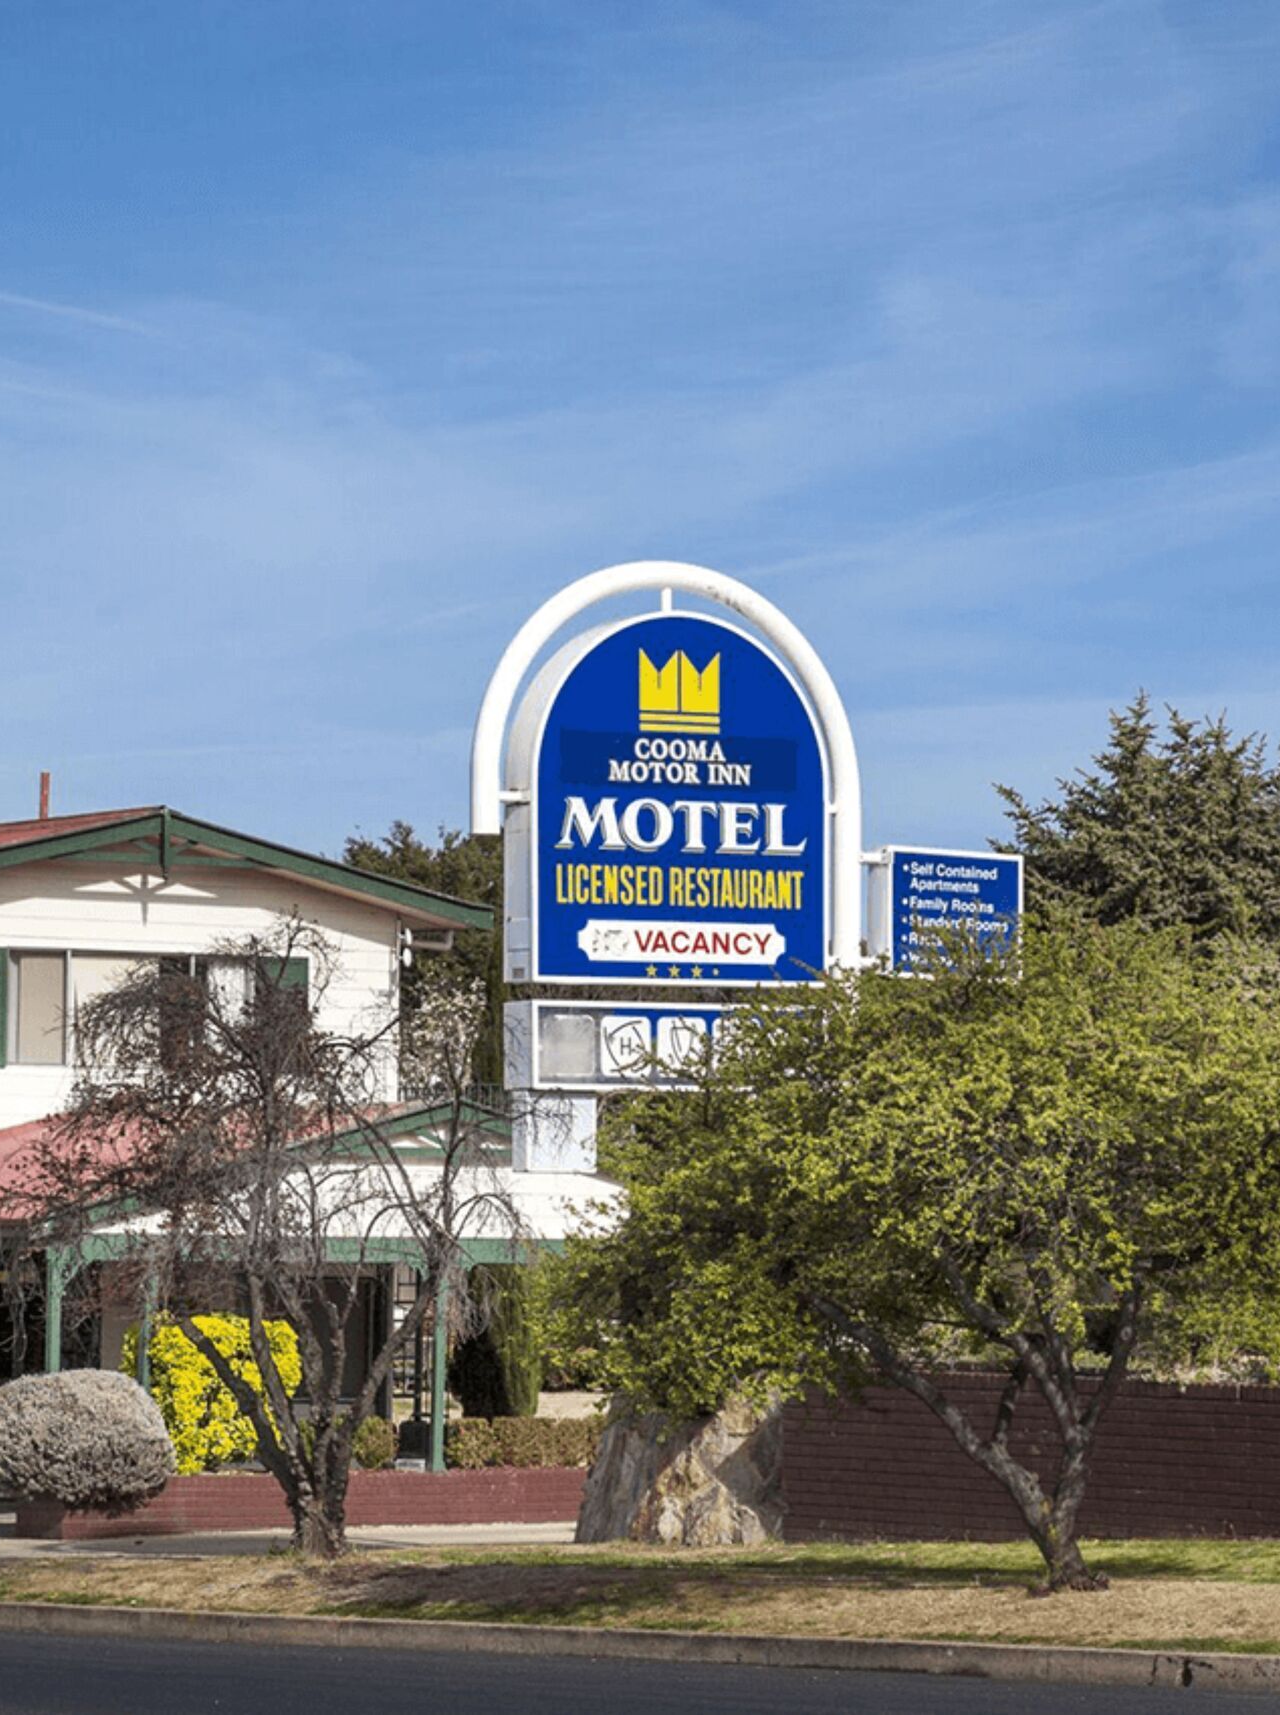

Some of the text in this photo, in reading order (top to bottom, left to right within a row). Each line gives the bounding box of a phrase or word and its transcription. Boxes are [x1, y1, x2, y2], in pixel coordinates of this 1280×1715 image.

[634, 738, 726, 762] COOMA
[608, 760, 751, 786] MOTOR INN
[553, 796, 808, 857] MOTEL
[910, 861, 998, 880] Self Contained
[556, 863, 804, 910] LICENSED RESTAURANT
[910, 877, 979, 894] Apartments
[910, 896, 948, 914] Family
[634, 929, 772, 955] VACANCY
